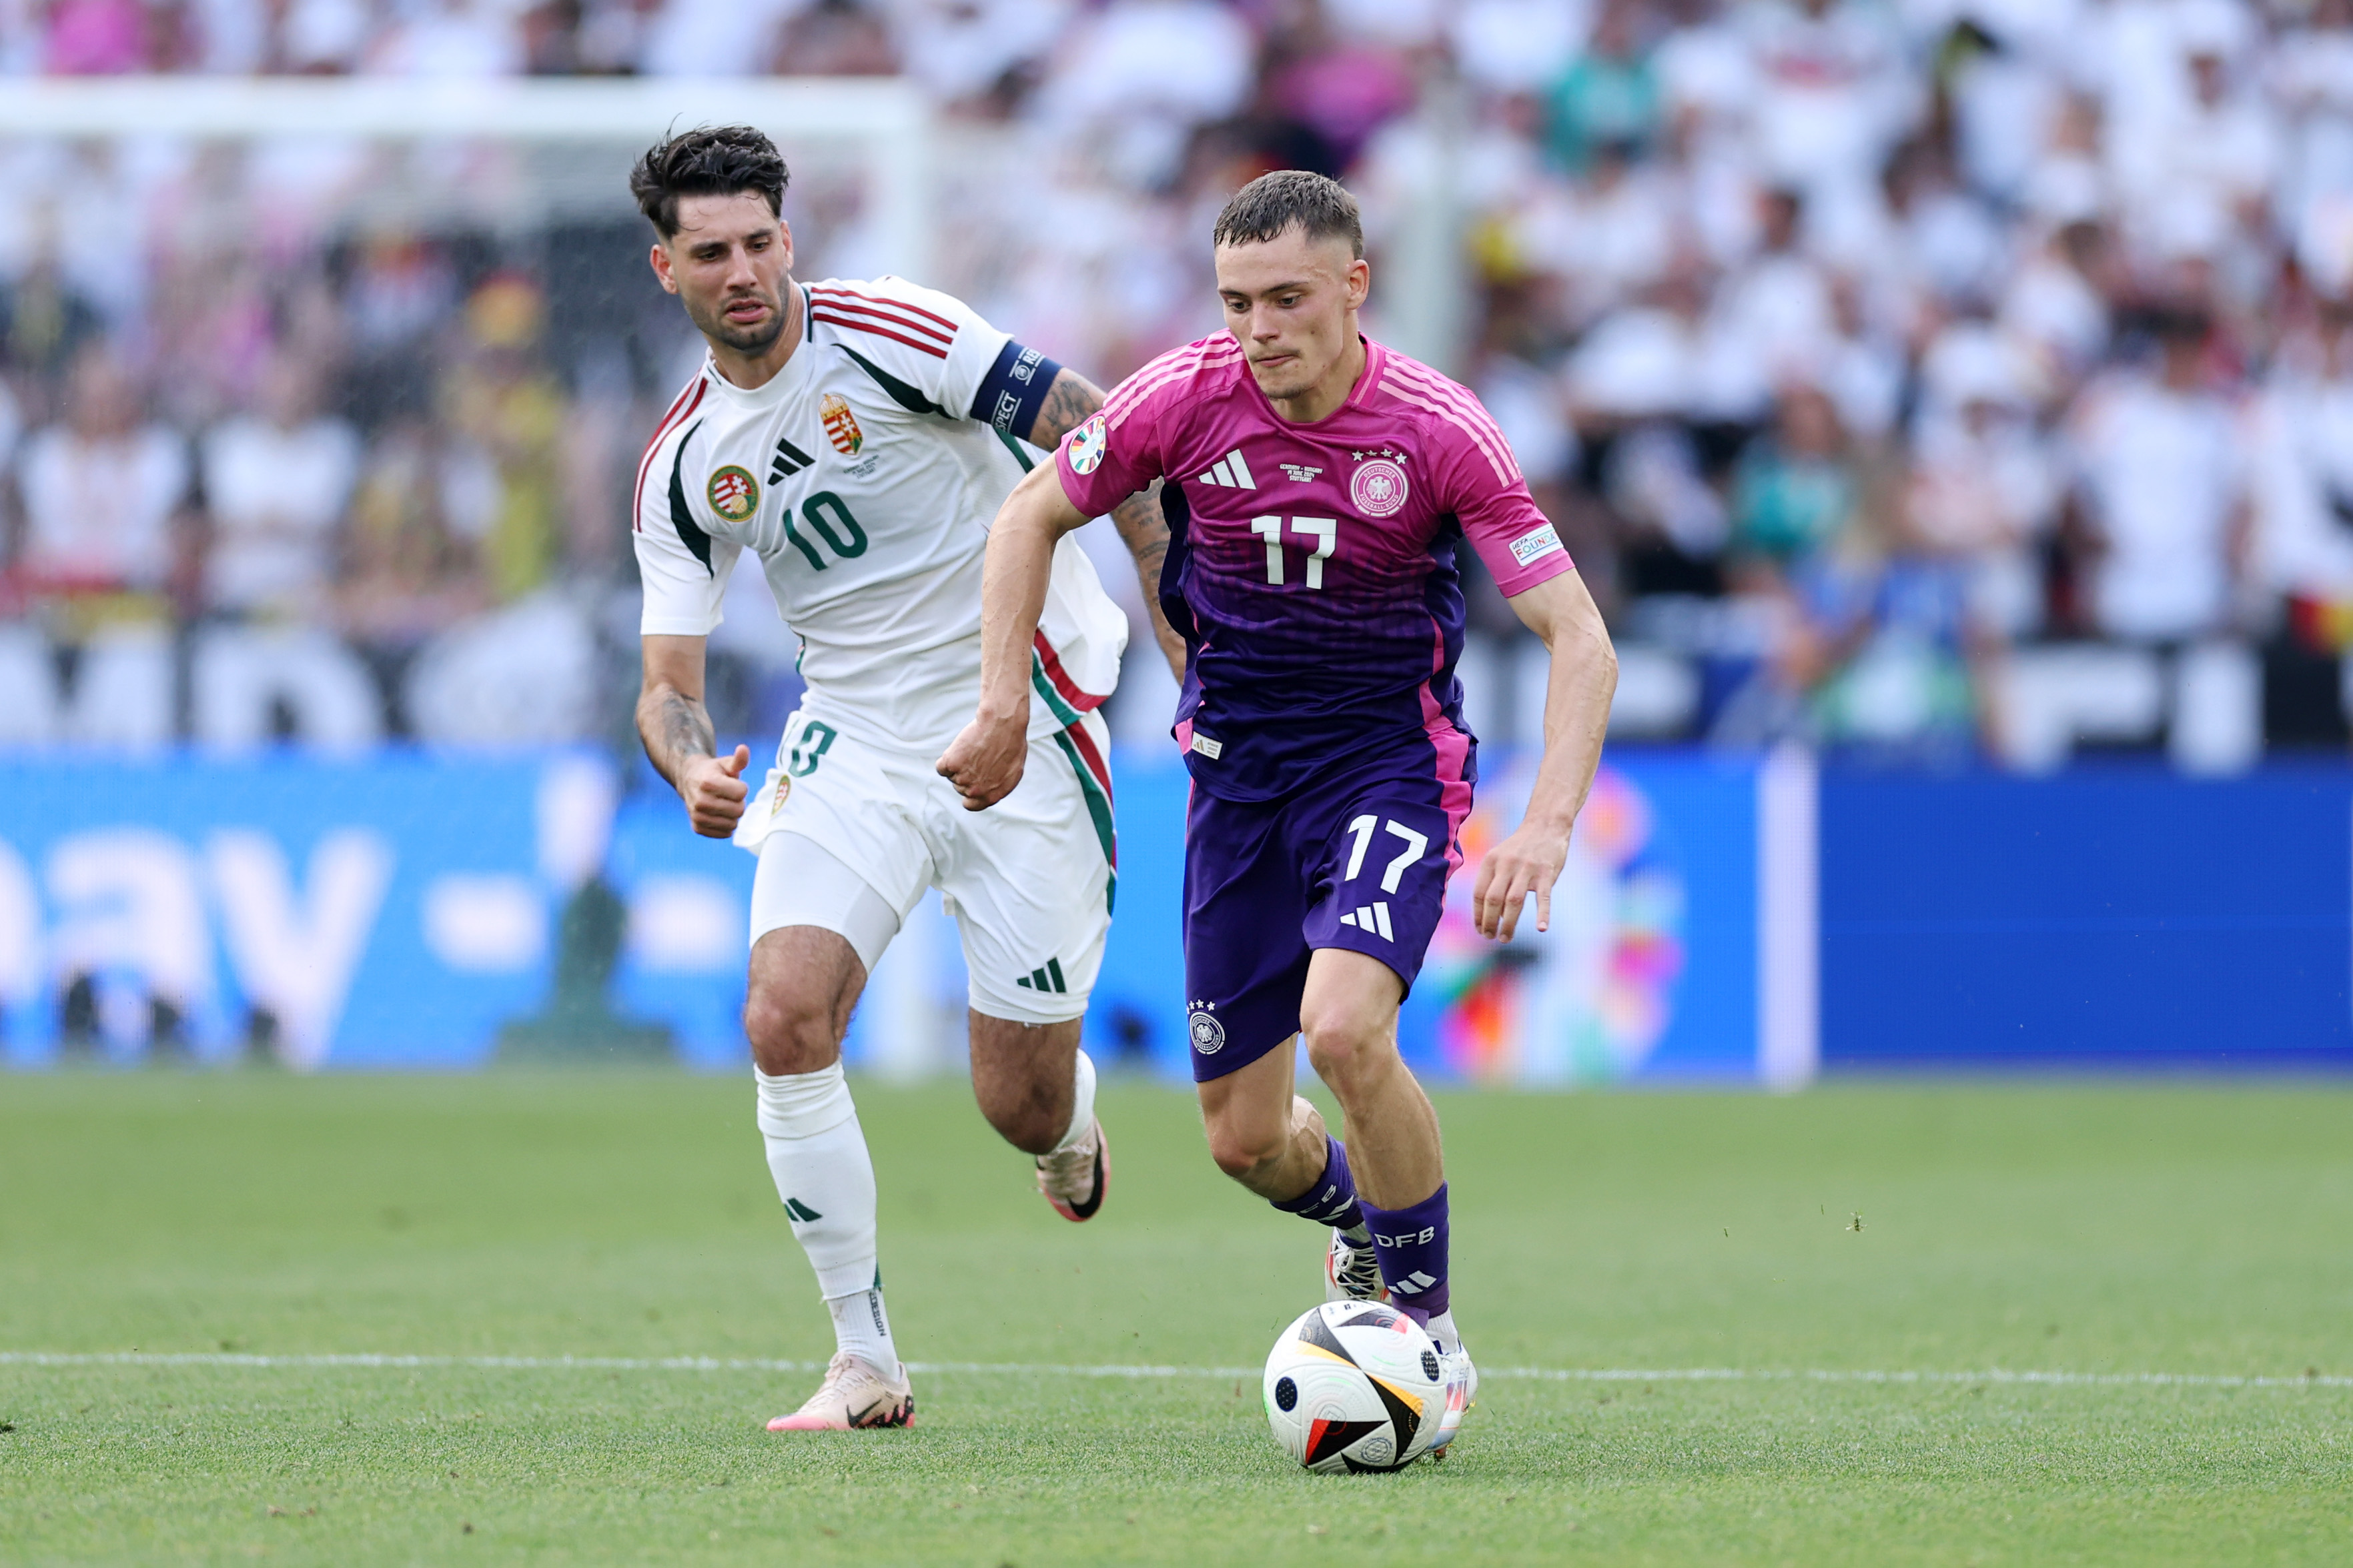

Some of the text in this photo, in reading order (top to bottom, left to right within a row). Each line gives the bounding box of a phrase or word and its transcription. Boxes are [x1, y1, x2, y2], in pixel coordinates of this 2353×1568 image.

[1289, 475, 1312, 483] STUTTGART
[1364, 468, 1396, 478] DEUTSCHER
[1360, 494, 1399, 510] FUSSBALL-BUND
[783, 491, 868, 572] 10
[1252, 515, 1337, 590] 17
[1512, 538, 1528, 550] UEFA
[1515, 532, 1557, 558] FOUNDA
[1345, 814, 1428, 894] 17
[1374, 1226, 1435, 1249] DFB
